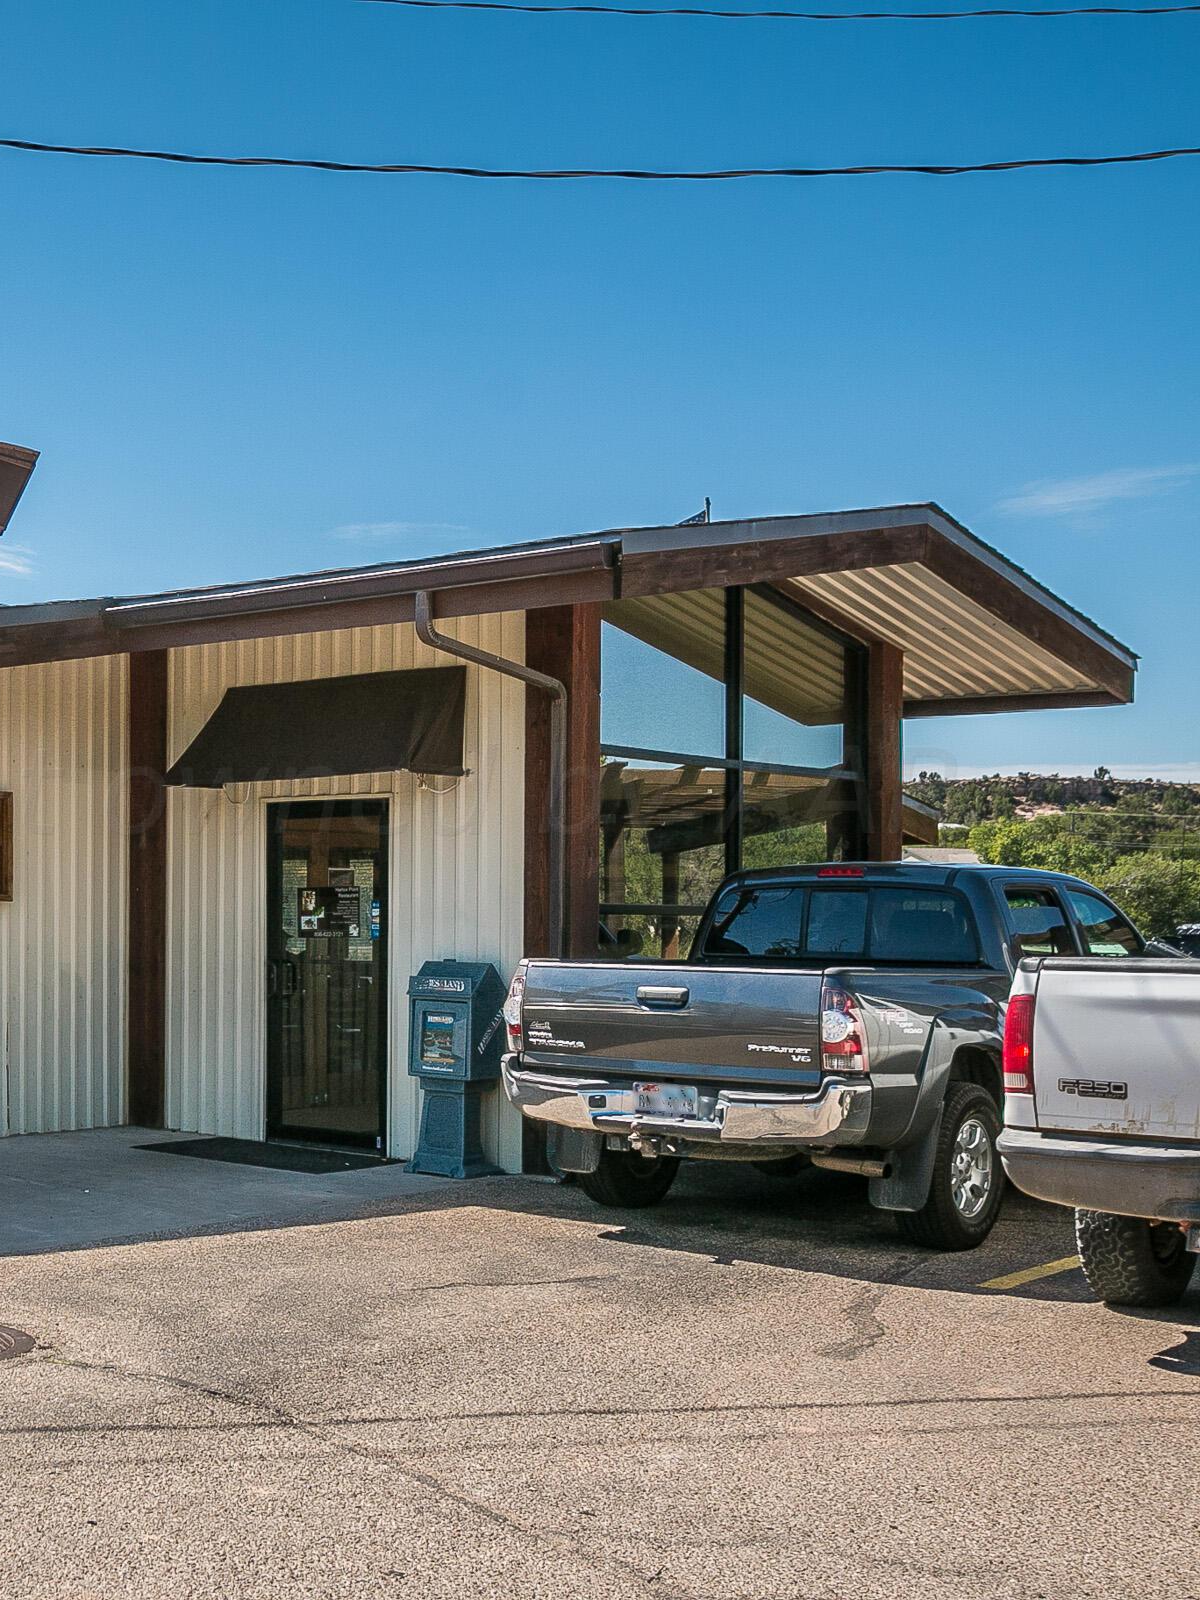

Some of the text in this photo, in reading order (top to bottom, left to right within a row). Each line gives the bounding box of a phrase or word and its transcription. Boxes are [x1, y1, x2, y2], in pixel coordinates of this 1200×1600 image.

[875, 1008, 908, 1025] TRD
[527, 1031, 553, 1039] TOYOTA
[528, 1038, 586, 1050] TACOMA
[747, 1043, 812, 1054] PreRunner
[791, 1054, 812, 1063] V6
[1059, 1078, 1126, 1094] F-250
